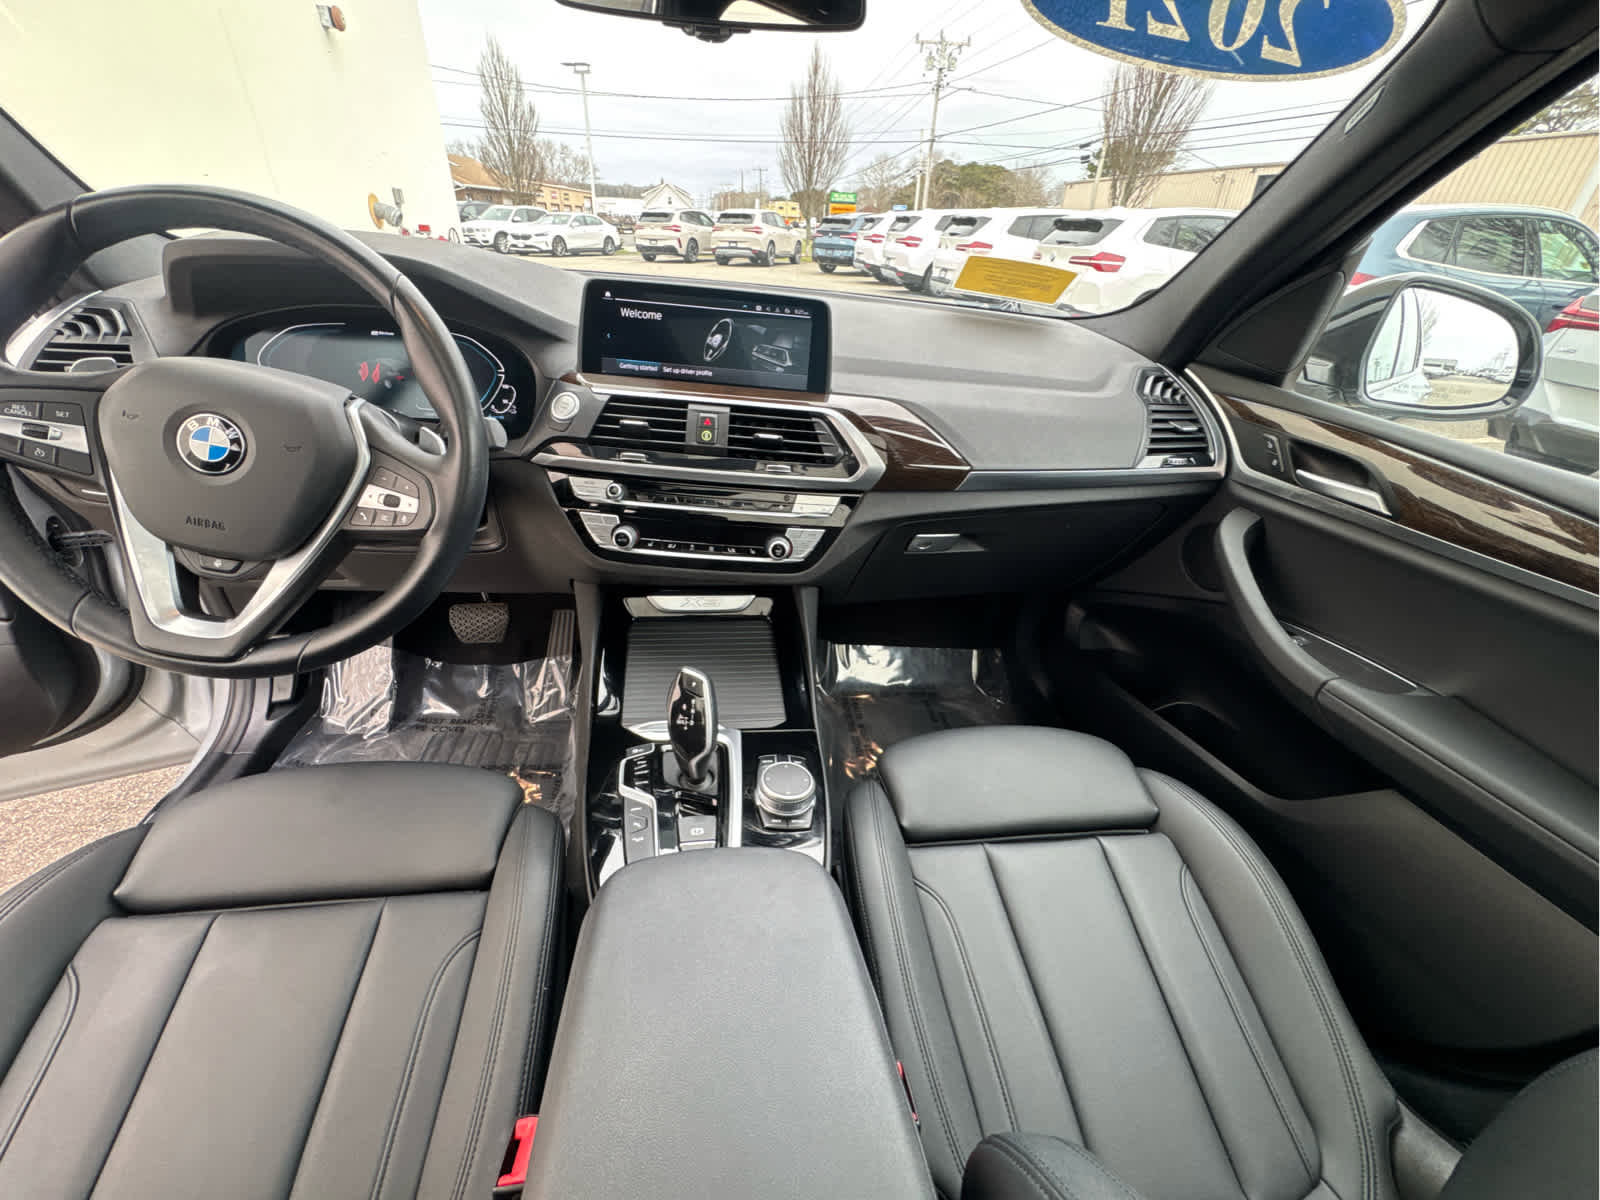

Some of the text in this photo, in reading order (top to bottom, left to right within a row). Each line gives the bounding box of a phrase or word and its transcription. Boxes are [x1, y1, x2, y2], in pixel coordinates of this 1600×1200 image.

[620, 307, 663, 321] Welcome
[187, 416, 240, 440] BMW
[186, 516, 226, 530] AIRBAG
